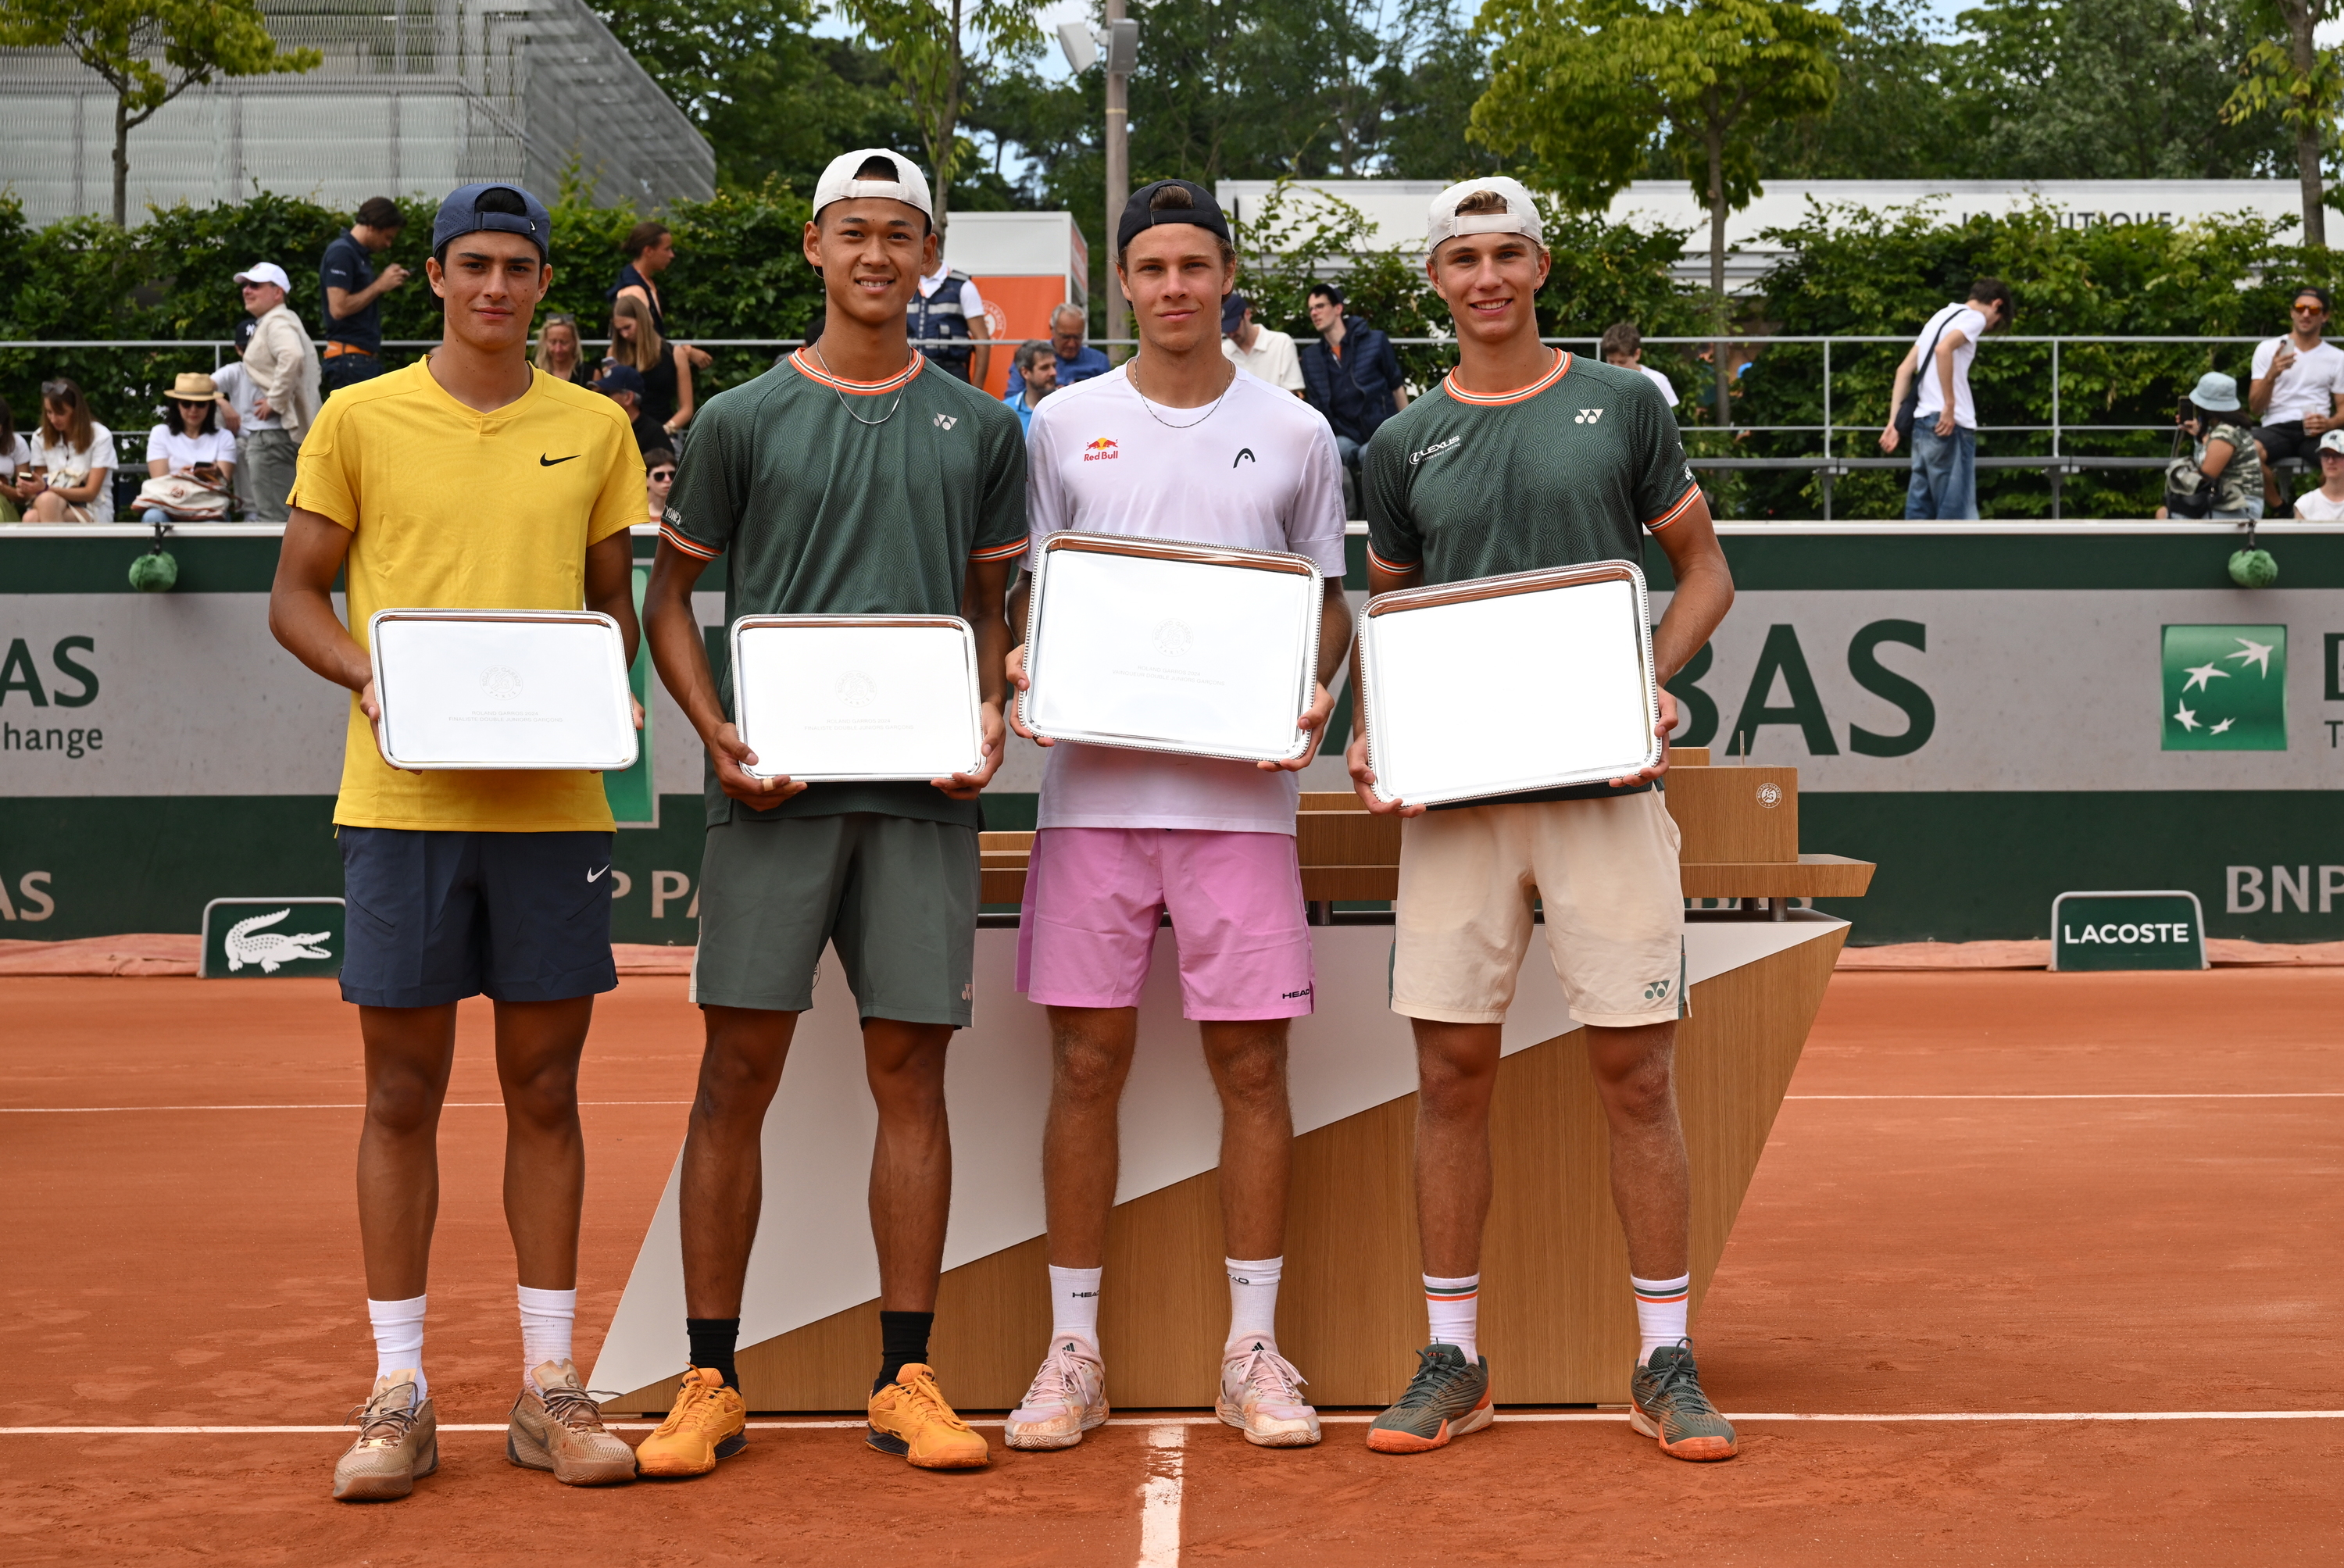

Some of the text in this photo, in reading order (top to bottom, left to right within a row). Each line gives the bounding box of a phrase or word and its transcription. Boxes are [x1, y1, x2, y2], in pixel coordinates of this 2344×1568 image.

[1420, 435, 1460, 456] LEXUS
[1084, 451, 1118, 462] Red Bull
[665, 505, 682, 526] YONEX
[481, 667, 521, 687] ROLAND GARROS
[4, 721, 102, 759] hange
[2226, 865, 2344, 913] BNP
[2064, 923, 2189, 944] LACOSTE
